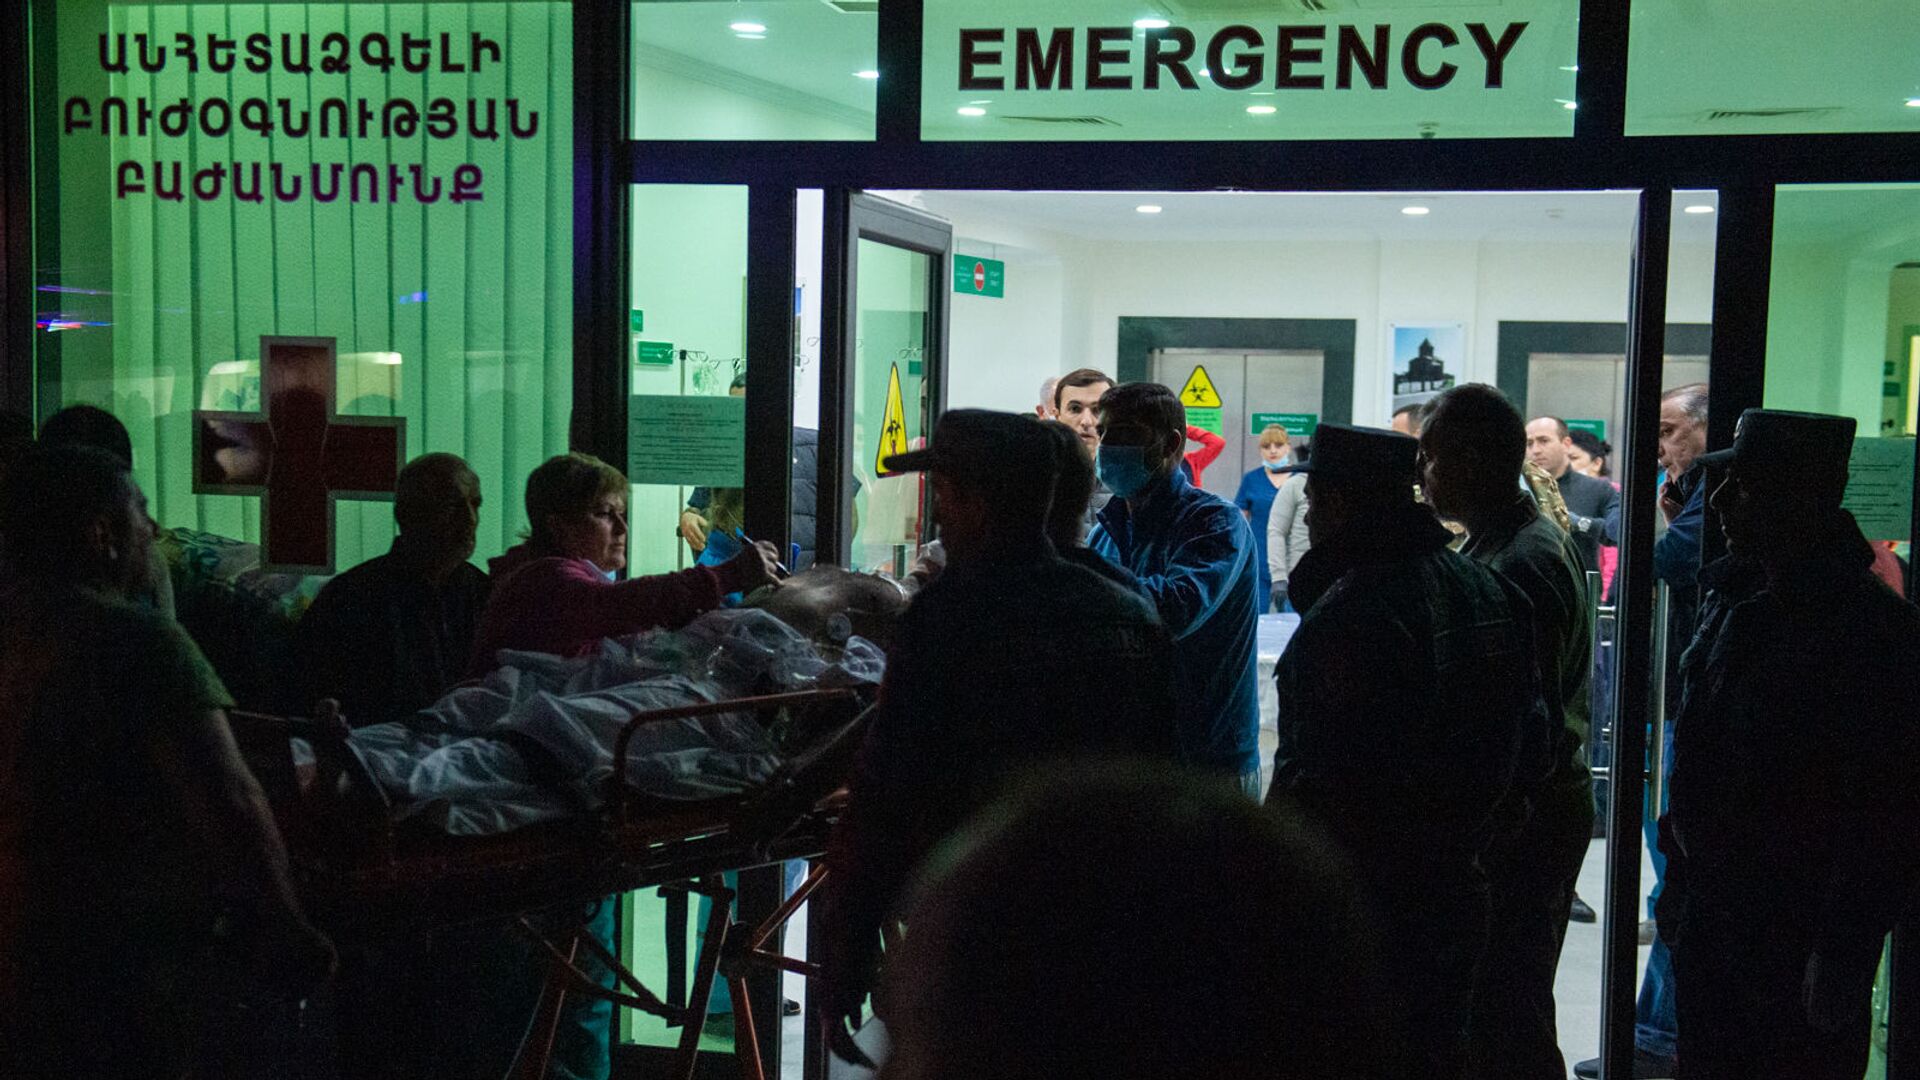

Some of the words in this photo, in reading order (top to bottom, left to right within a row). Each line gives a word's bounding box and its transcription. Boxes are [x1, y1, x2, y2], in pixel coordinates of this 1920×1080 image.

[98, 33, 503, 74] ԱՆՀԵՏԱՁԳԵԼԻ
[958, 23, 1528, 91] EMERGENCY
[64, 96, 540, 139] ԲՈՒԺՕԳՆՈՒԹՅԱՆ
[116, 161, 485, 204] ԲԱԺԱՆՄՈՒՆՔ
